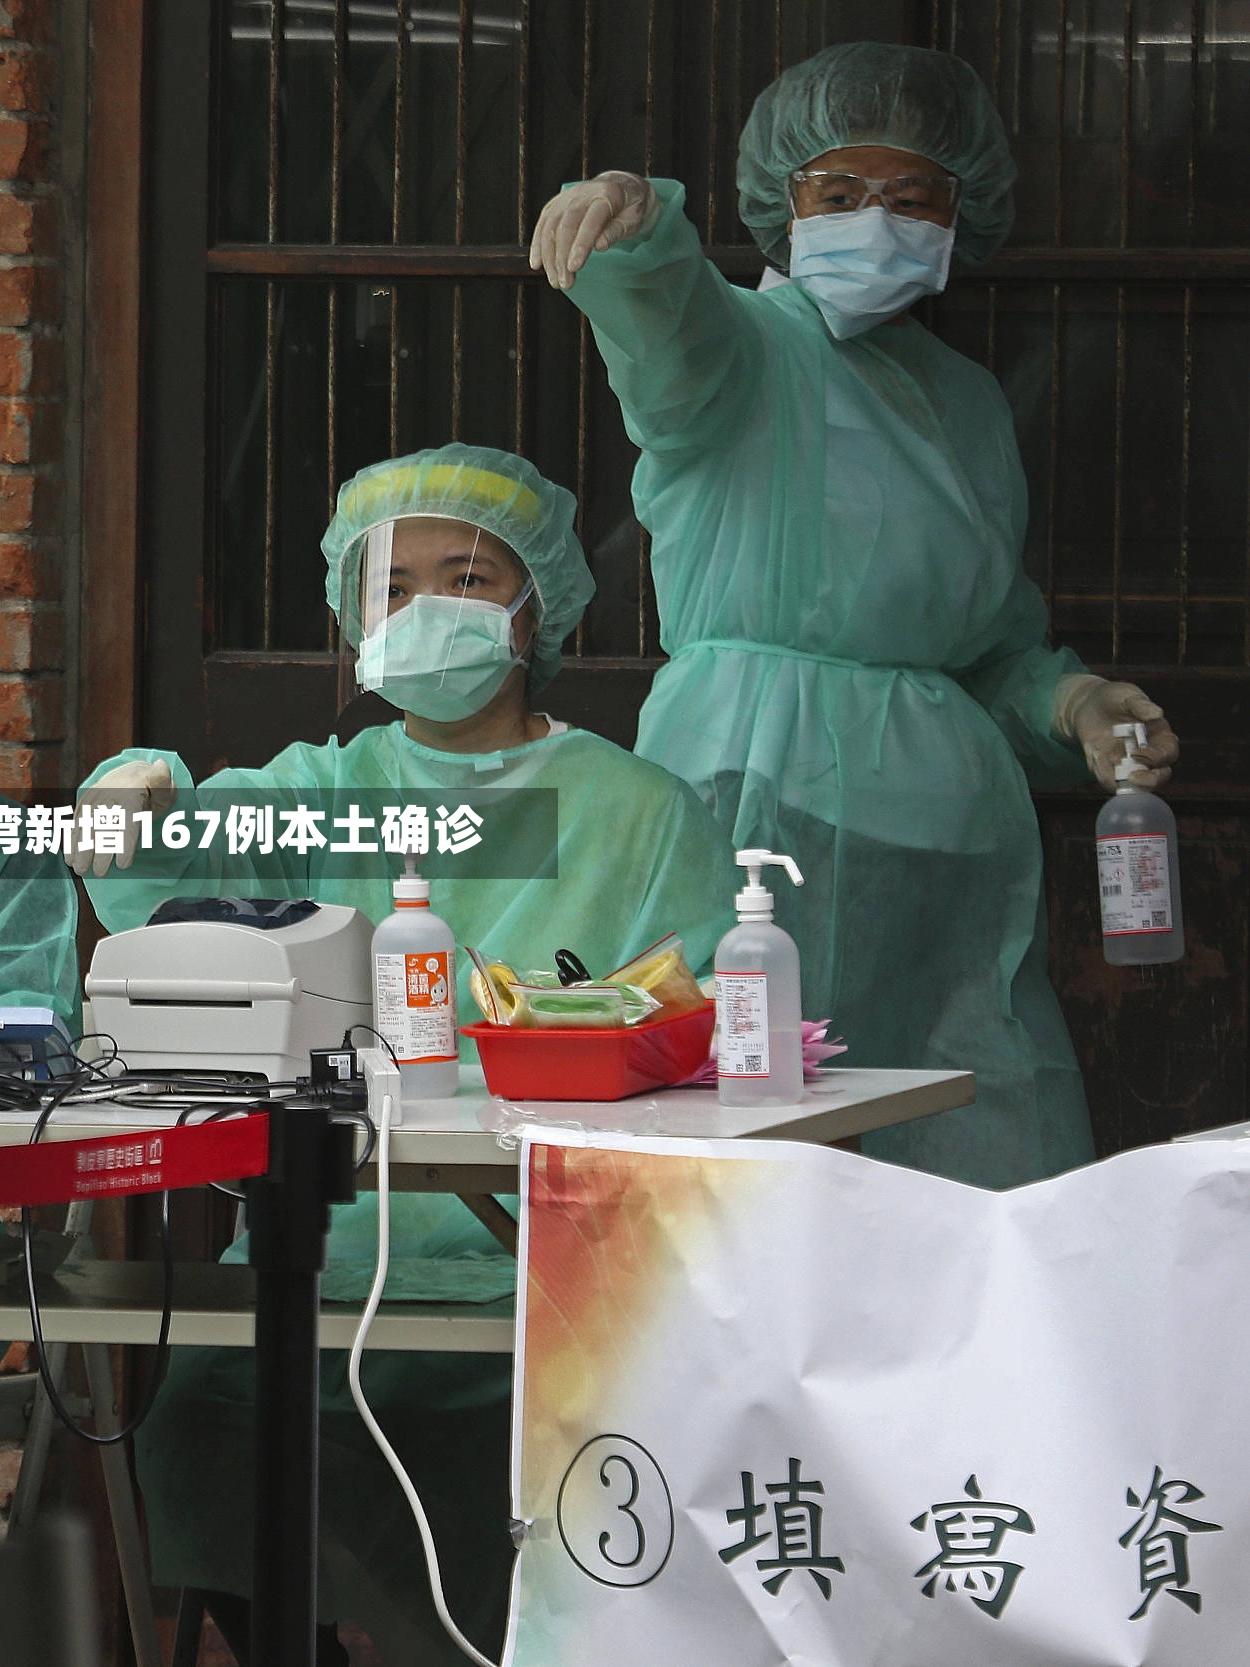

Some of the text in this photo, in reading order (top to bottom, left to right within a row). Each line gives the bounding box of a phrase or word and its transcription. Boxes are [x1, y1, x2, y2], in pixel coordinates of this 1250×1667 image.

[141, 1171, 162, 1185] Block
[718, 1457, 1224, 1623] 填寫資
